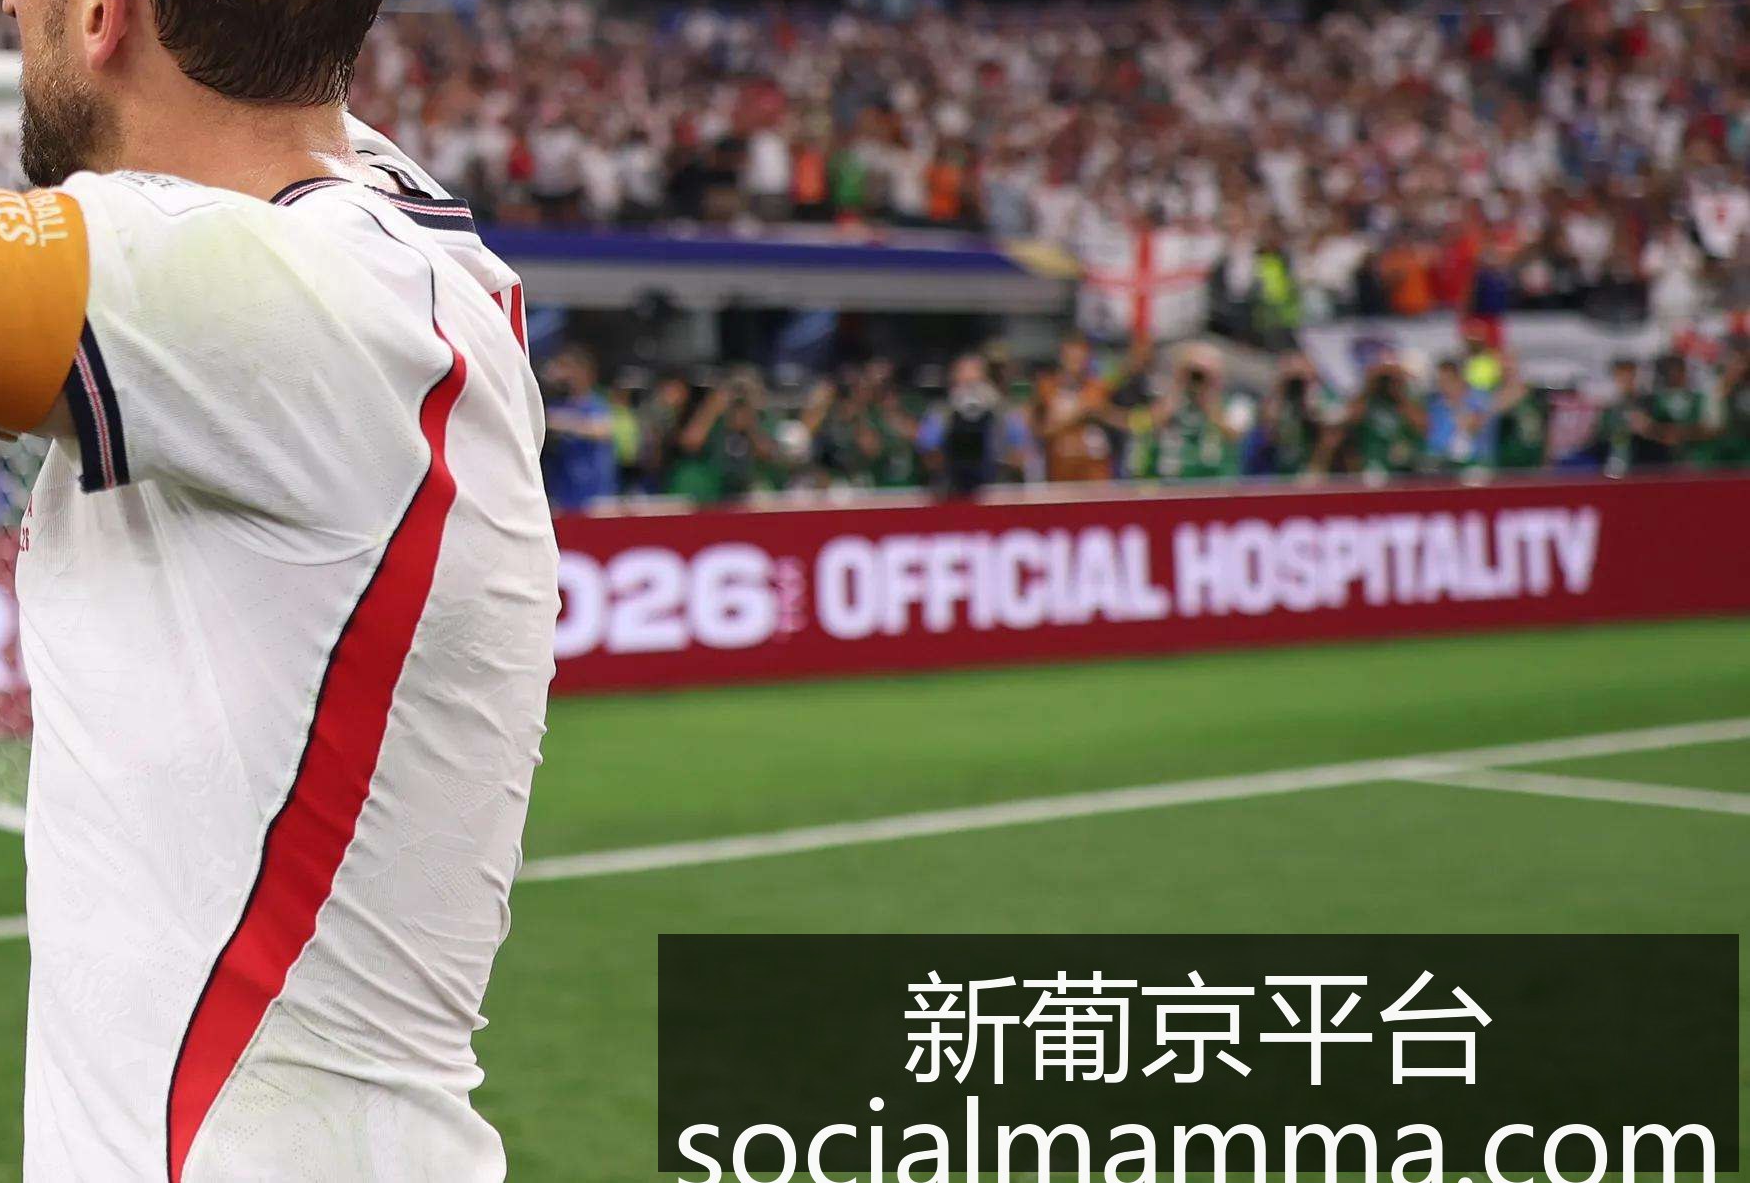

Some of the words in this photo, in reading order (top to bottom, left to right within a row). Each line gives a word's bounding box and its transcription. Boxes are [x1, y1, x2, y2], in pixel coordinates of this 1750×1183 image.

[25, 187, 69, 248] BALL
[553, 545, 778, 658] 026
[816, 530, 1170, 638] OFFICIAL
[1174, 508, 1598, 615] HOSPITALITY
